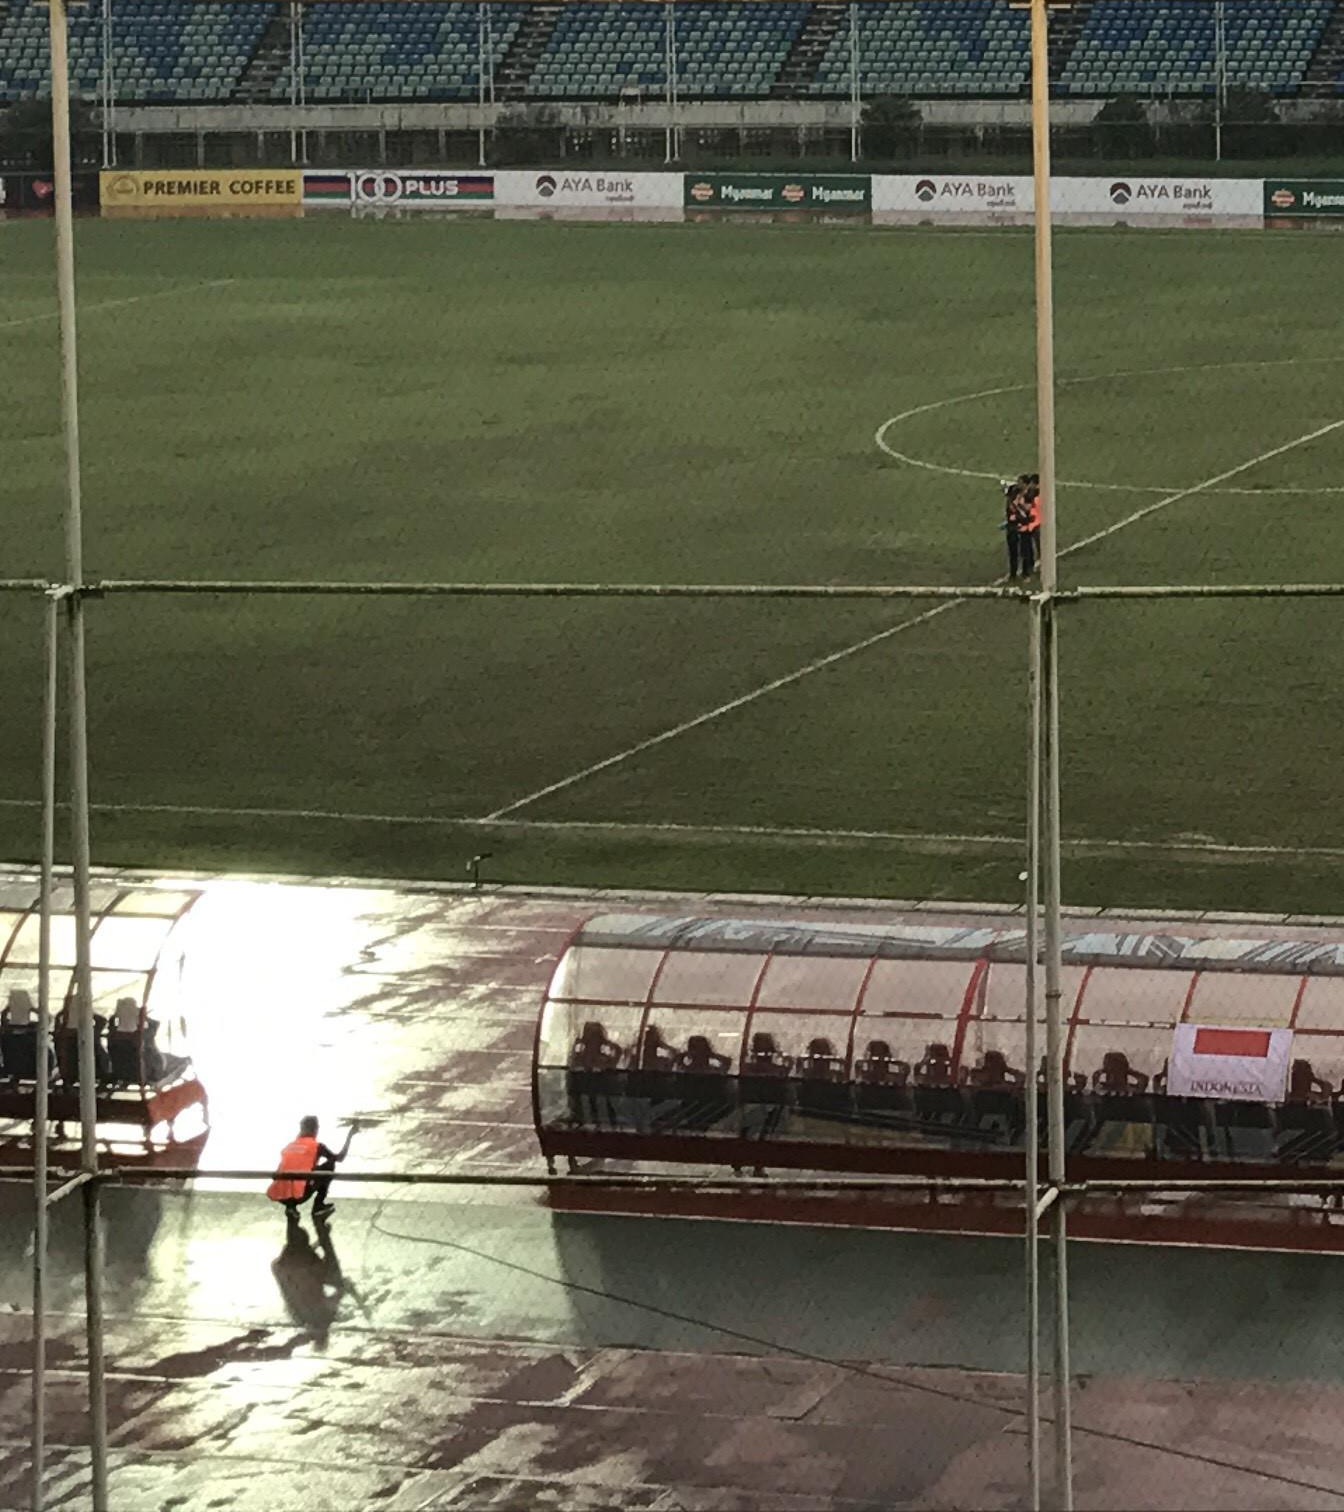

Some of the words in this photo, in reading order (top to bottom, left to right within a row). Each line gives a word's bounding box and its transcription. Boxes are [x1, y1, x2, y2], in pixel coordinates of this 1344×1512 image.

[143, 180, 221, 195] PREMIER
[229, 180, 296, 195] COFFEE
[561, 179, 593, 192] AYA
[596, 179, 633, 193] Bank
[941, 182, 973, 196] AYA
[977, 183, 1015, 197] Bank
[1137, 184, 1169, 198] AYA
[1173, 184, 1212, 199] Bank
[1190, 1080, 1264, 1096] INDONESIA
